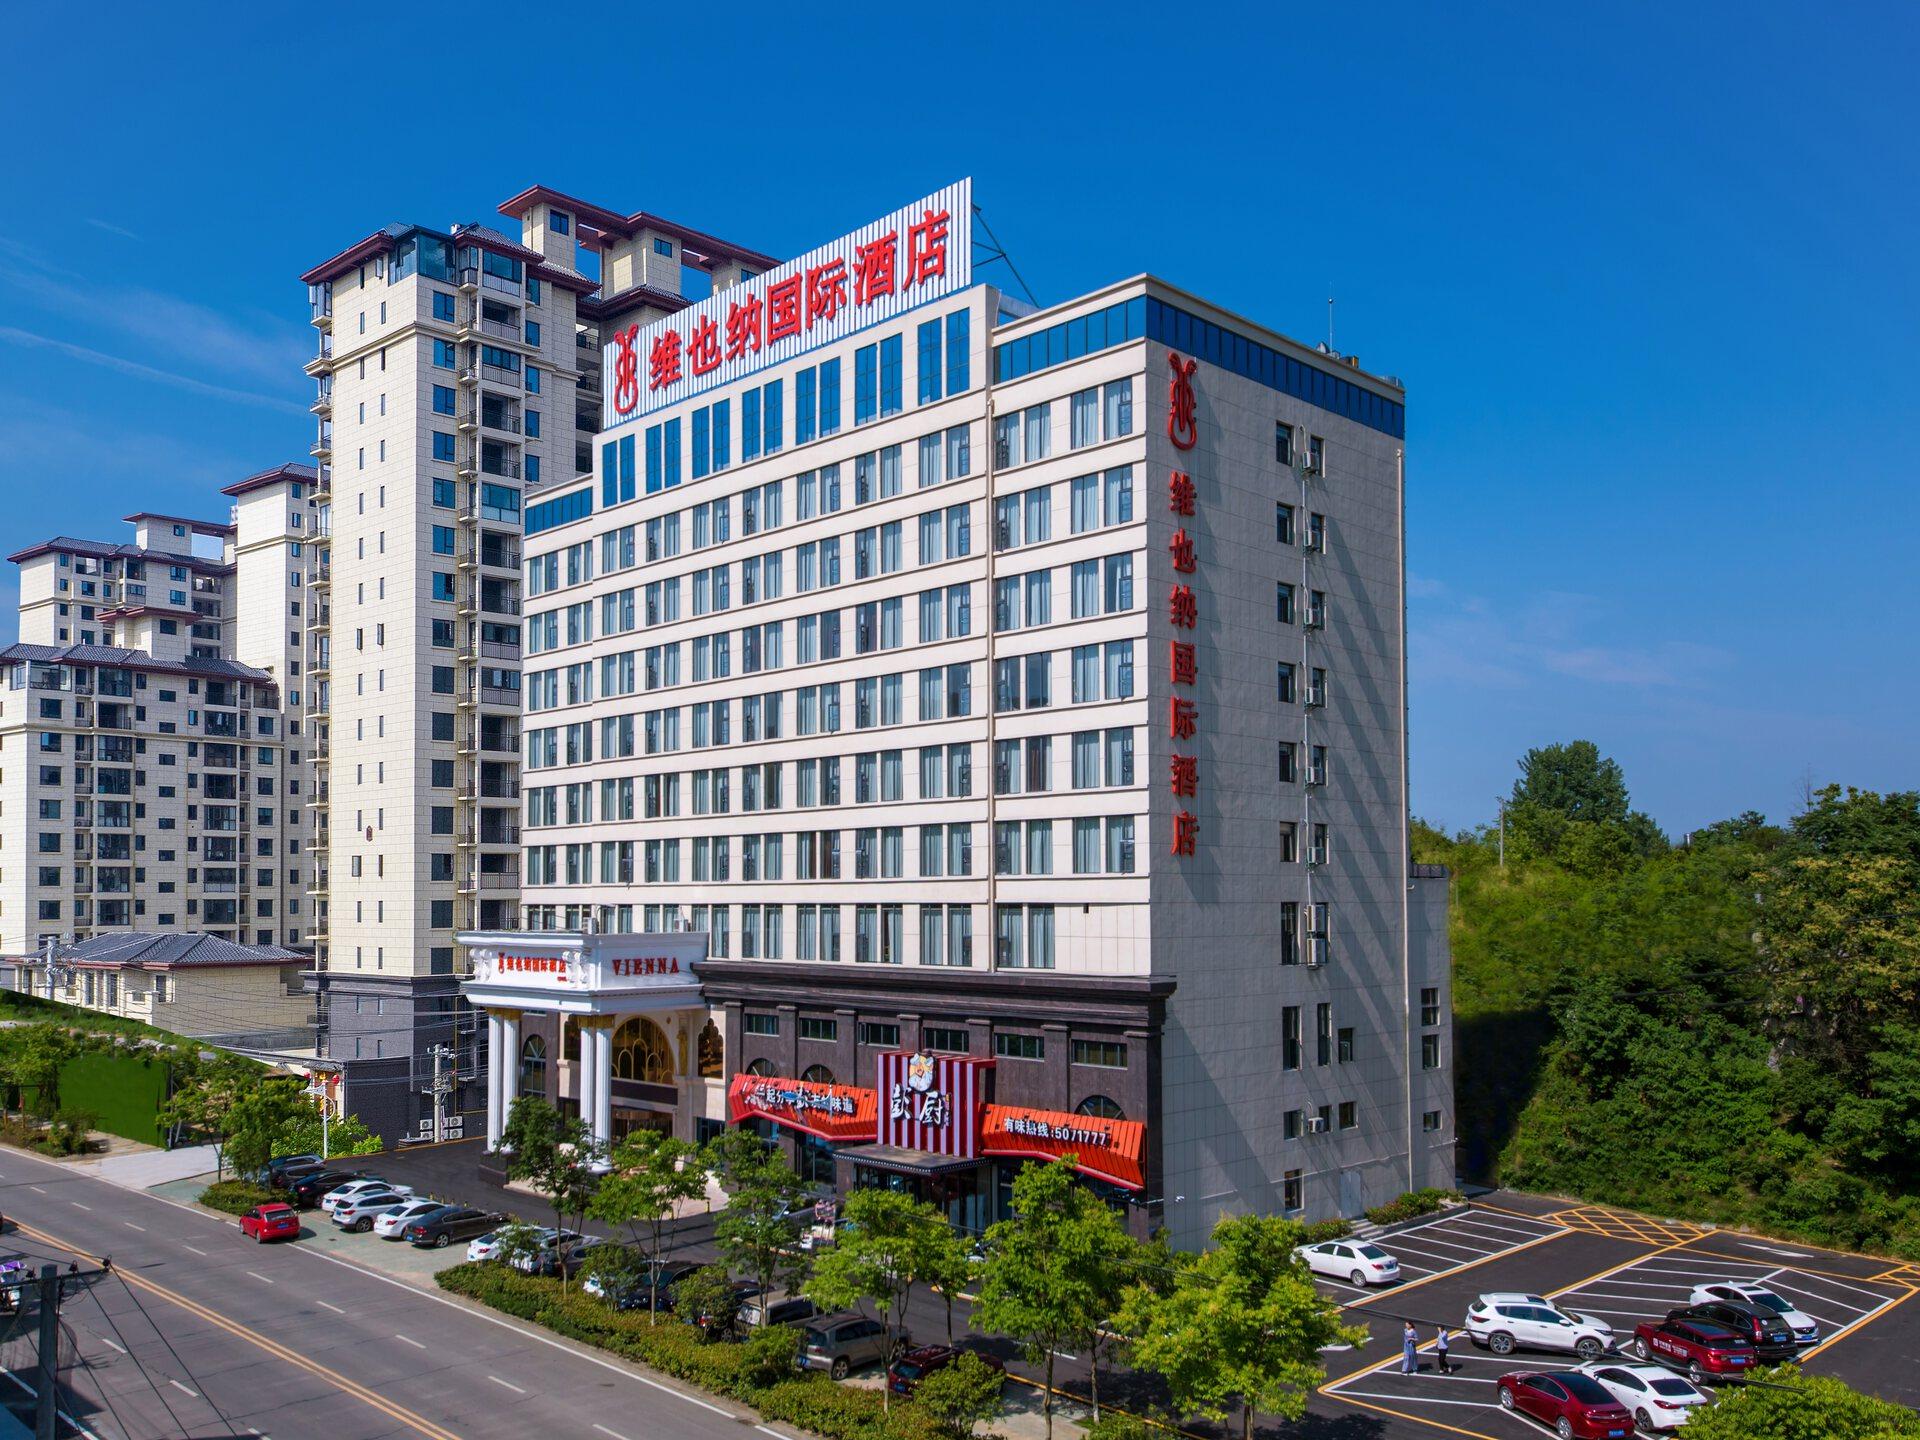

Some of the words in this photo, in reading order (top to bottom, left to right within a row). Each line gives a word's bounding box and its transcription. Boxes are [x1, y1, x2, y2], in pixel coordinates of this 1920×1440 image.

[649, 208, 951, 391] 维也纳国际酒店
[1168, 471, 1196, 857] 维也纳国际酒店
[612, 957, 680, 976] VIENNA
